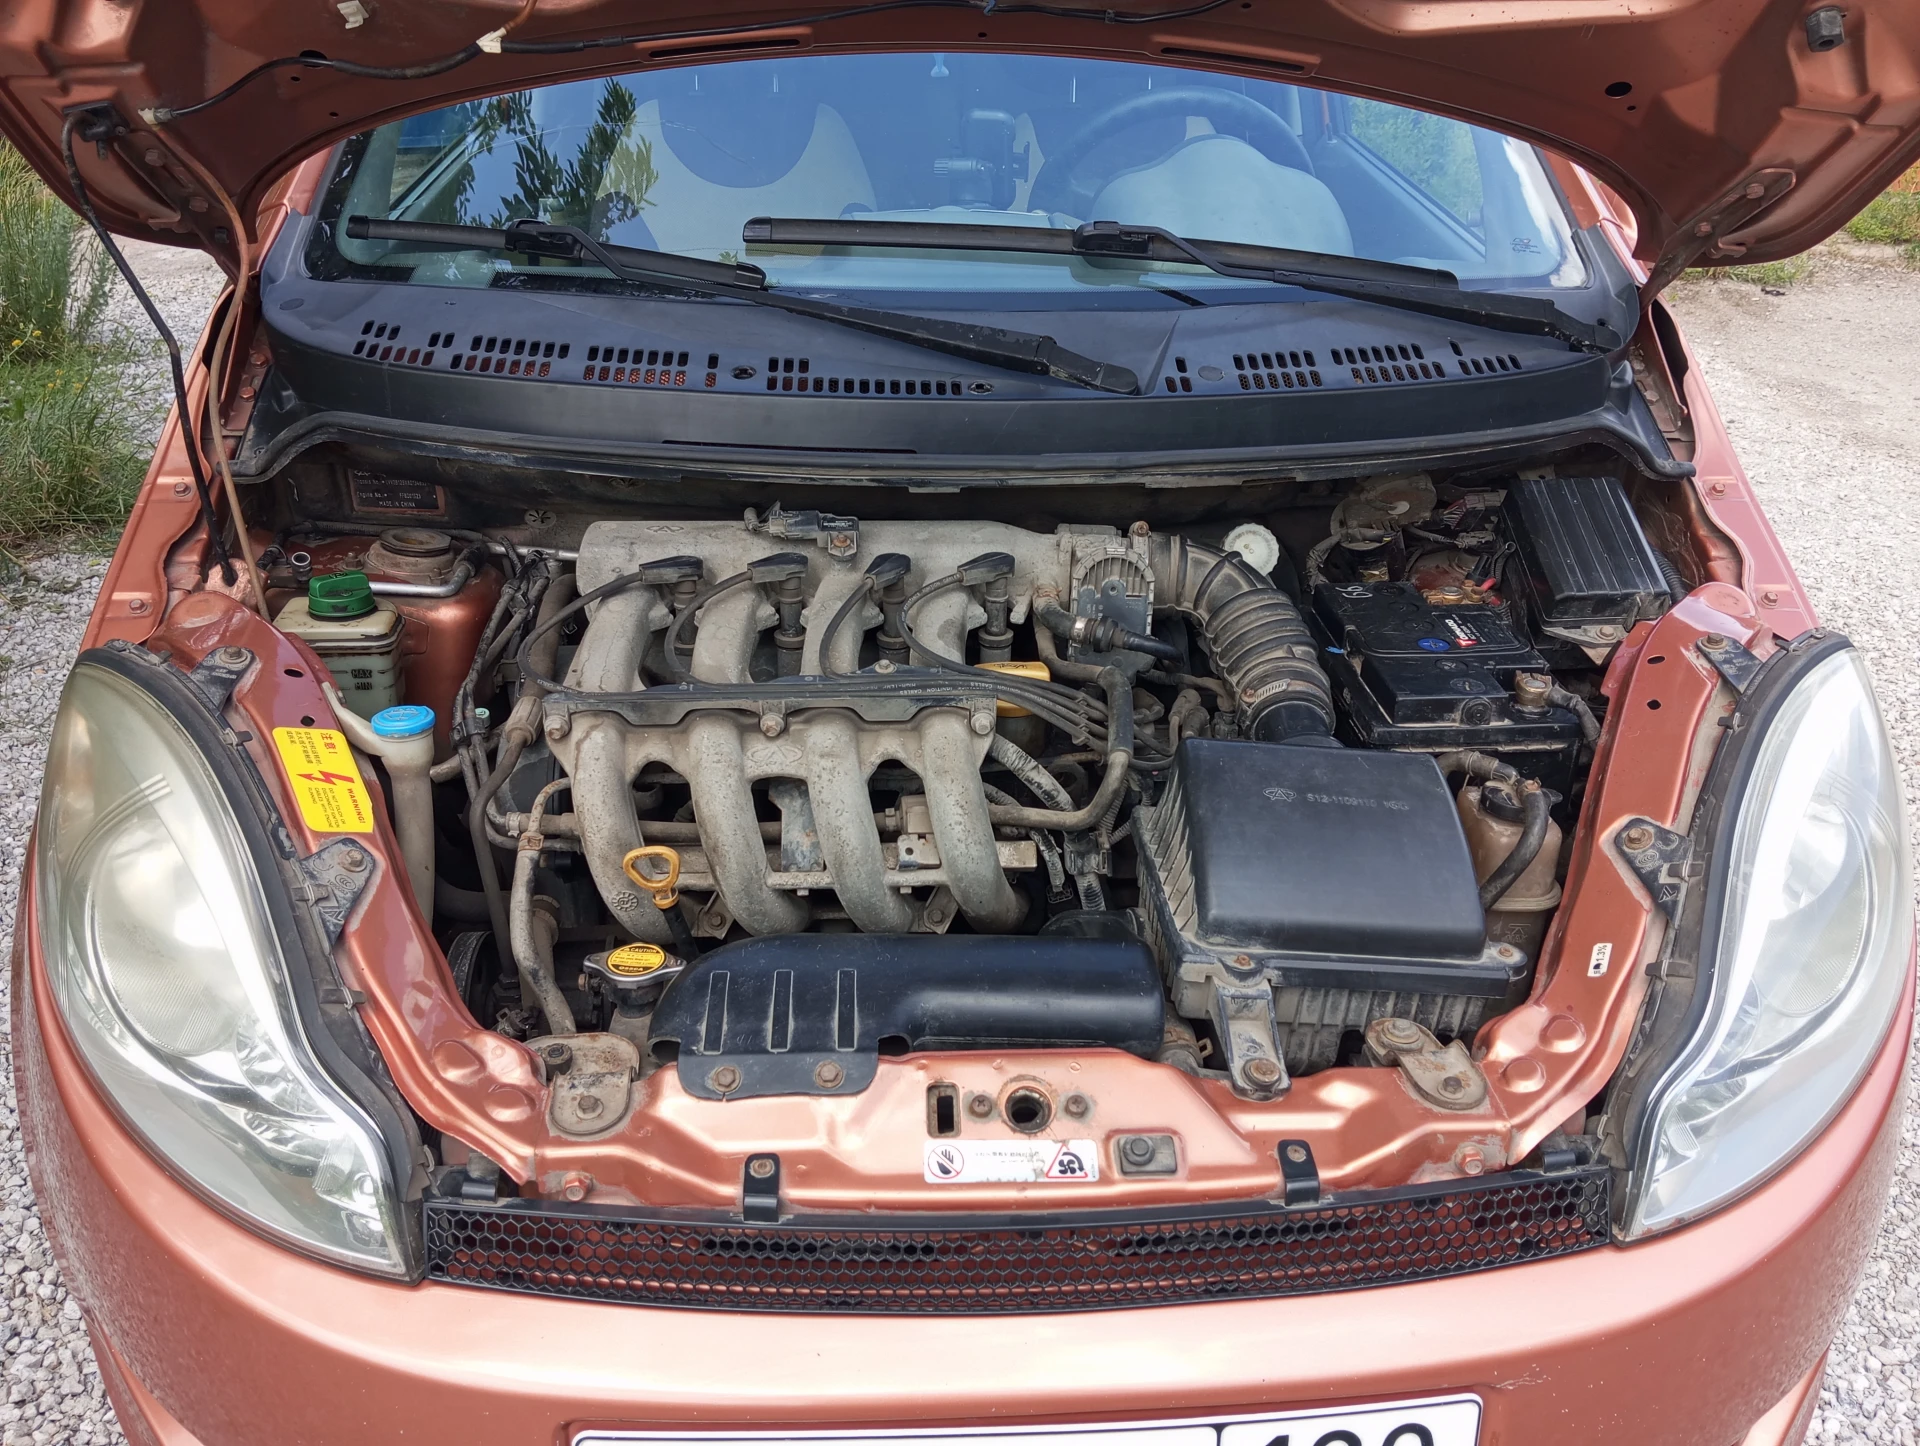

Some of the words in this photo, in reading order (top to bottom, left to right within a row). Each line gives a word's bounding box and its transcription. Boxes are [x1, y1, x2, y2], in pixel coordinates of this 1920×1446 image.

[351, 669, 373, 679] MAX
[355, 681, 373, 691] MIN
[308, 787, 317, 805] RUNNING
[321, 788, 334, 812] DISCONNECT
[314, 787, 324, 802] CABLES
[324, 813, 334, 828] ENGINE
[347, 788, 366, 824] WARNING!
[1595, 945, 1608, 962] 1.3%
